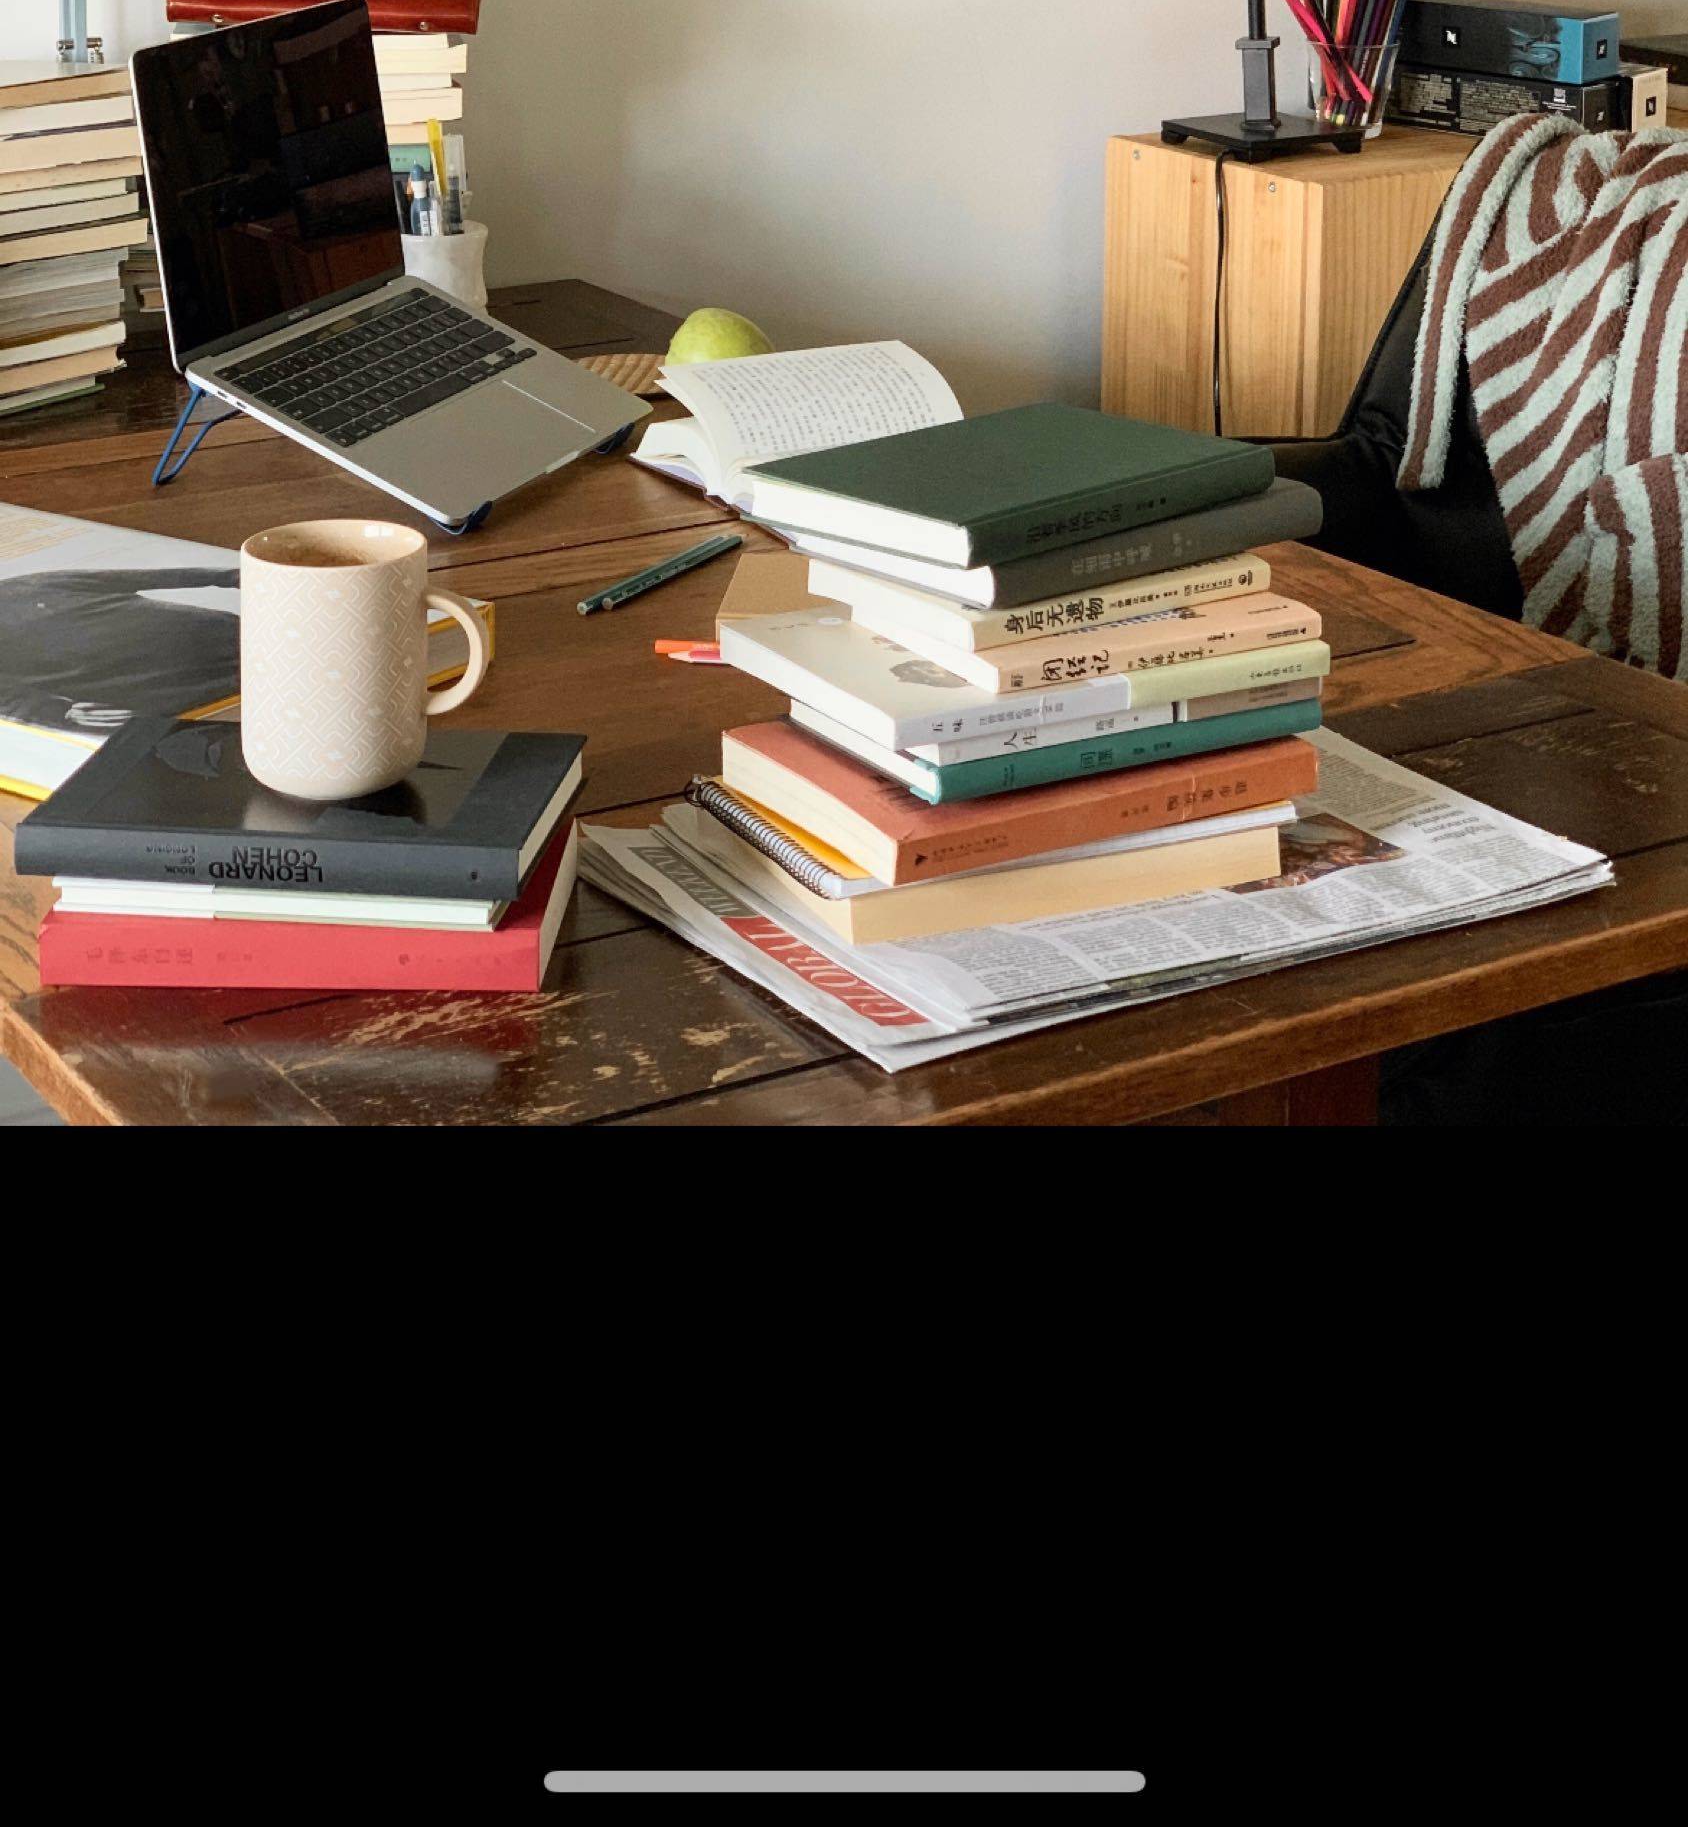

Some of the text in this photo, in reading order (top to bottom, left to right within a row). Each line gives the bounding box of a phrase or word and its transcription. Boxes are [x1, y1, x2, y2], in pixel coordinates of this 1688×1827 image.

[1004, 597, 1105, 635] 身后无遗物
[1040, 649, 1111, 682] 闭经记
[1003, 726, 1037, 748] 人生
[180, 855, 195, 864] OF
[231, 846, 317, 868] COHEN
[165, 866, 195, 875] BOOK
[208, 860, 323, 883] LEONARD
[742, 923, 911, 1018] GLOBAL
